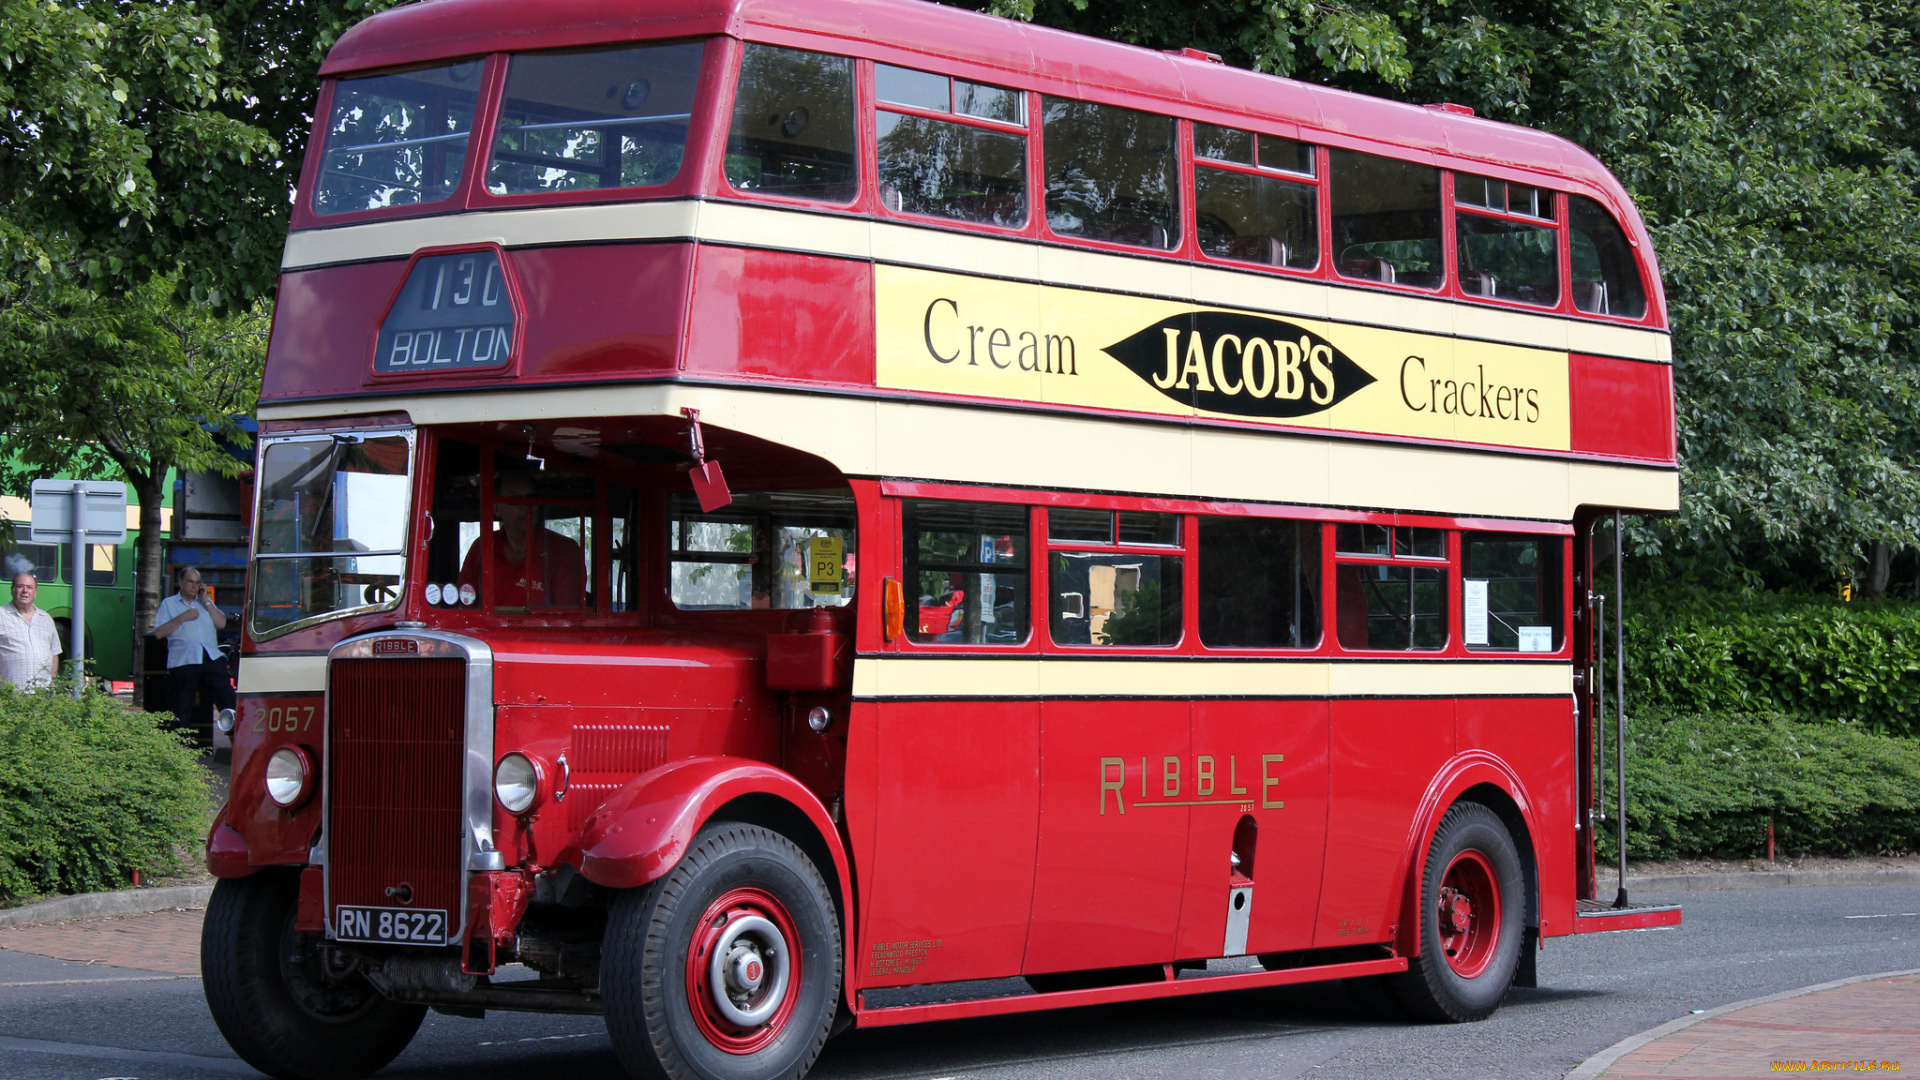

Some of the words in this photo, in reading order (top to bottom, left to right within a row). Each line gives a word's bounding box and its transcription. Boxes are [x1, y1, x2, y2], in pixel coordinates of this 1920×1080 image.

[432, 257, 500, 310] 130
[389, 327, 510, 366] BOLTON
[923, 298, 1079, 376] Cream
[1152, 327, 1335, 406] JACOB'S
[1400, 355, 1541, 424] Crackers
[817, 561, 834, 576] P3
[375, 641, 416, 653] RIBBLE
[252, 706, 315, 733] 2057
[1100, 754, 1284, 815] RIBBLE
[1240, 804, 1255, 812] 2057
[340, 910, 371, 938] RN
[378, 912, 442, 941] 8622
